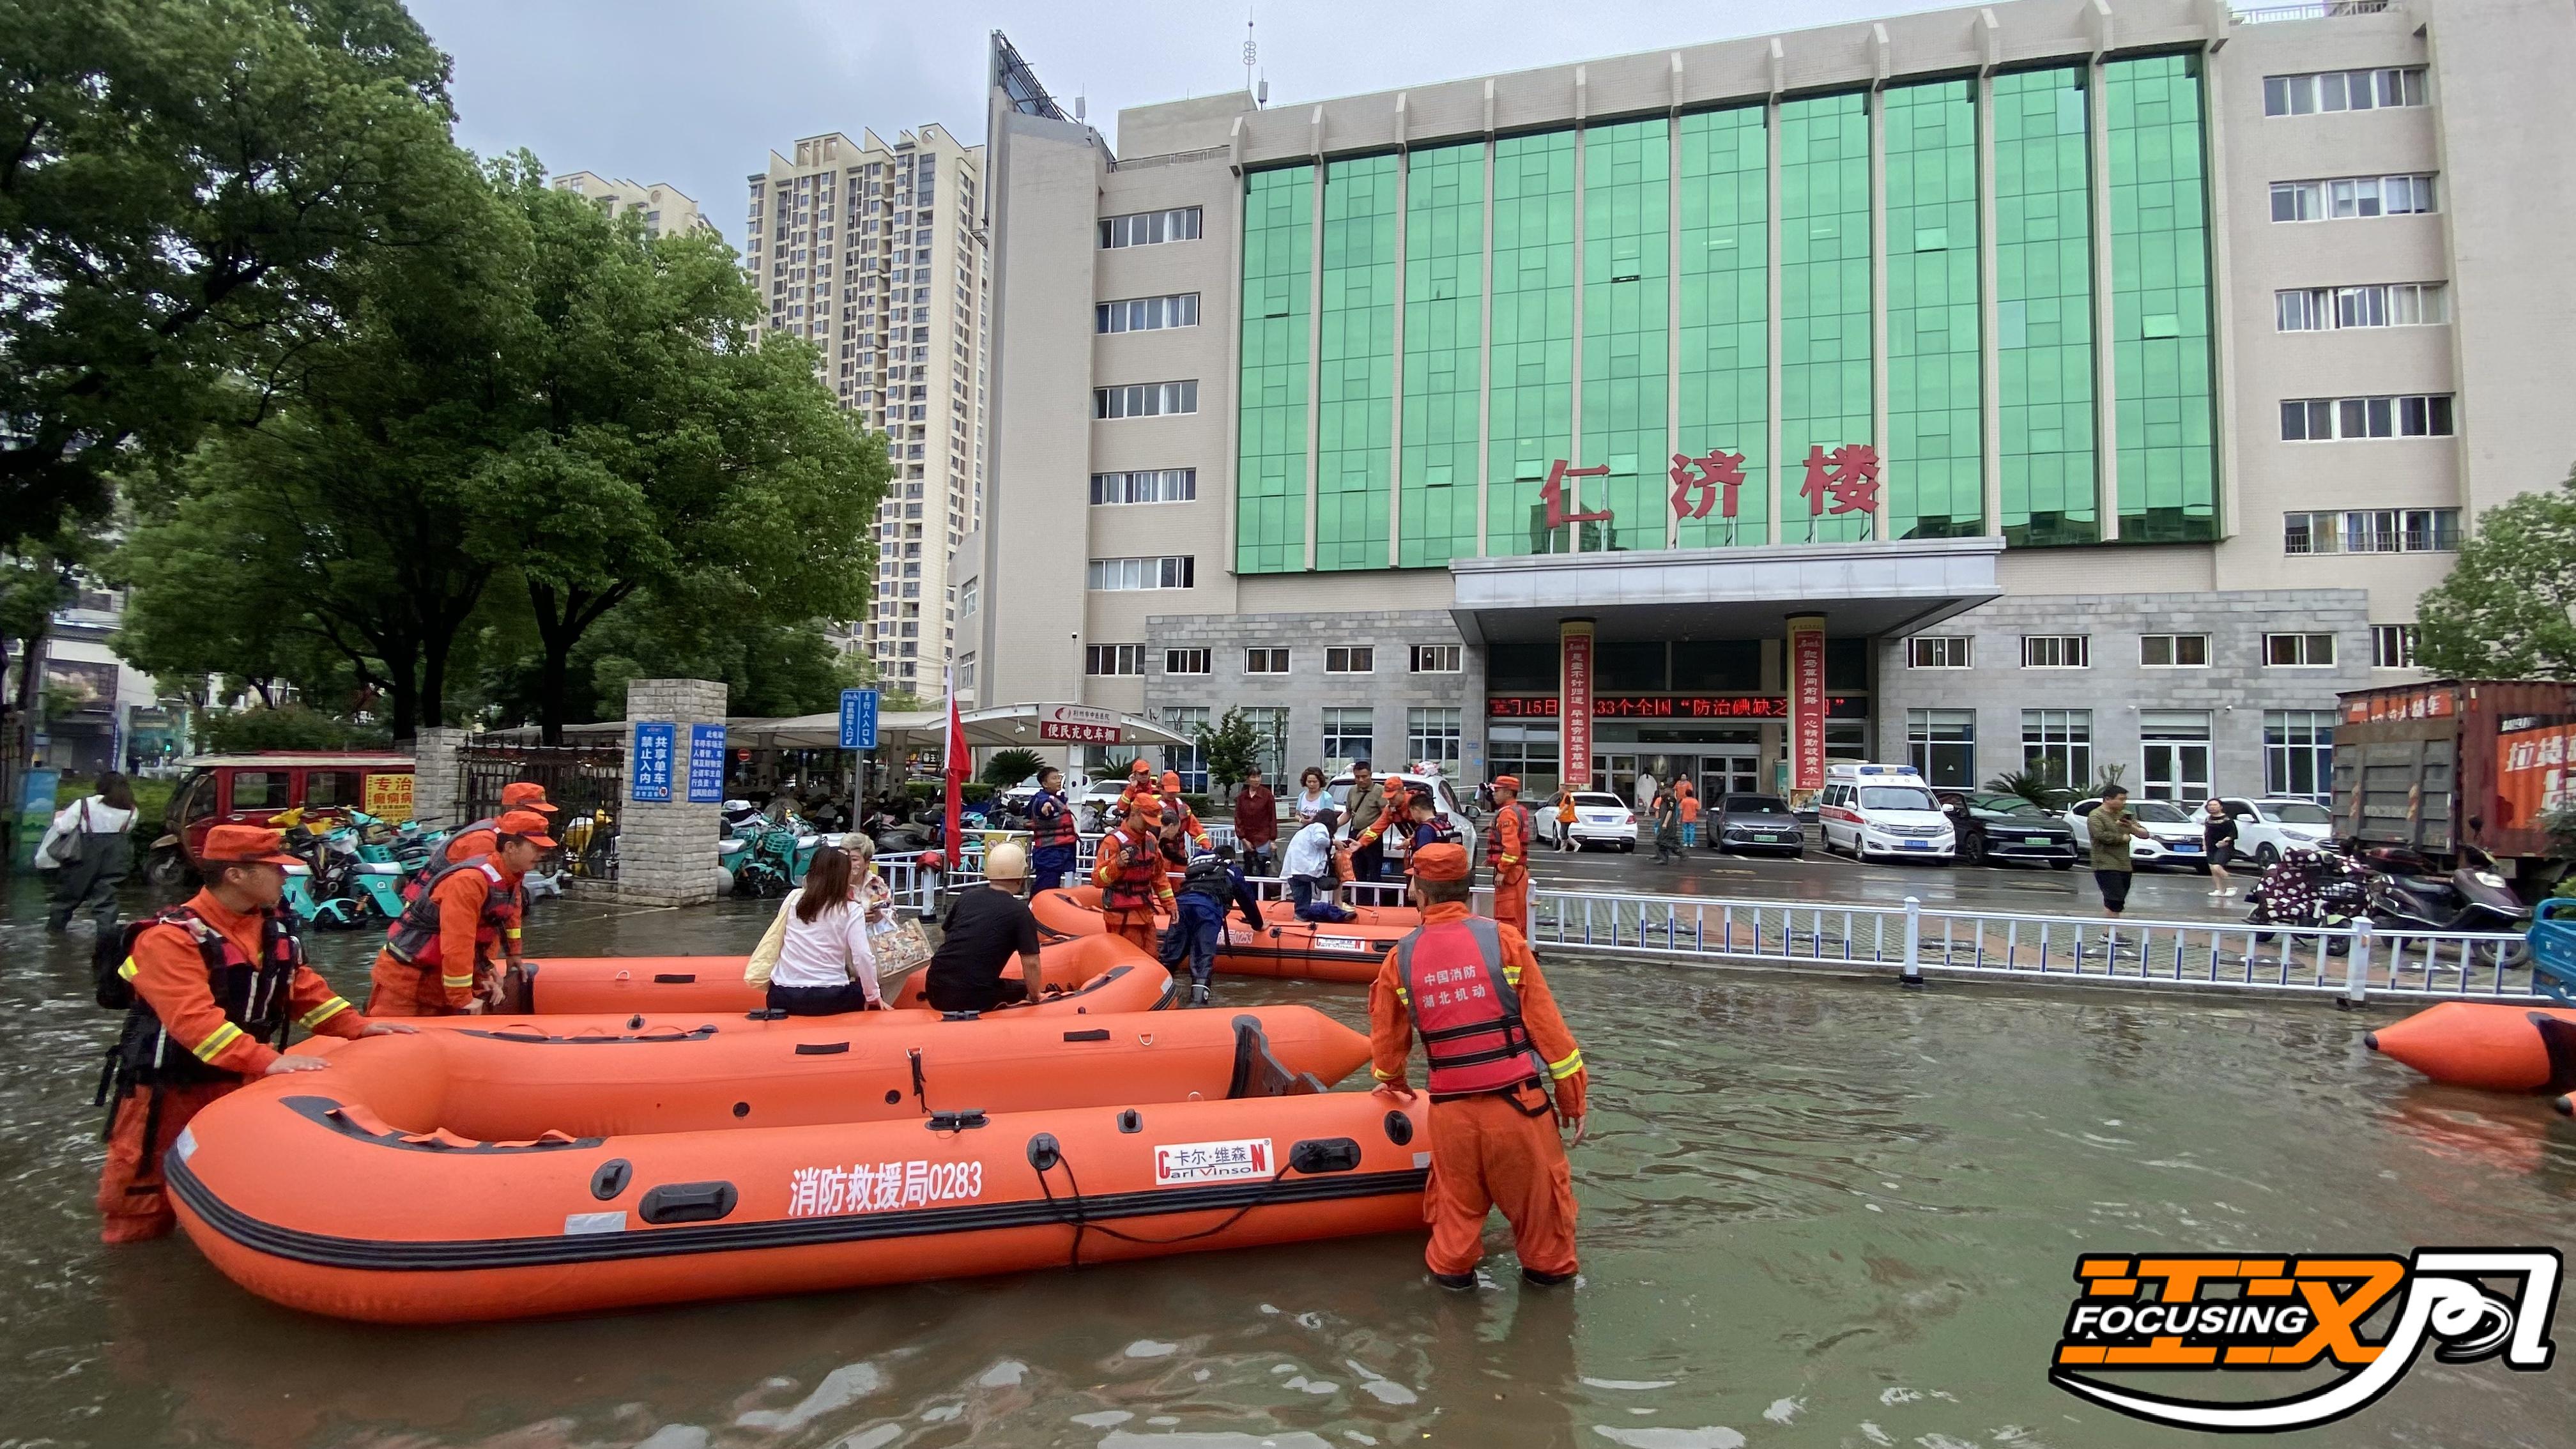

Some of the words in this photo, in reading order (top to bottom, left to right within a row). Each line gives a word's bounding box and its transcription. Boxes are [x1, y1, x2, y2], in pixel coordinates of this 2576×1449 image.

[1539, 443, 1880, 528] 仁济楼
[862, 702, 871, 737] 行人入口
[1047, 723, 1116, 742] 便民充电车棚
[640, 736, 654, 785] 禁止入内
[653, 736, 668, 785] 共享单车
[374, 777, 413, 791] 专治
[1424, 965, 1476, 986] 中国消防
[1422, 984, 1486, 1009] 湖北机动
[1158, 1151, 1193, 1179] Carl
[1174, 1146, 1246, 1167] 卡尔·维森
[788, 1160, 982, 1216] 消防救援局0283
